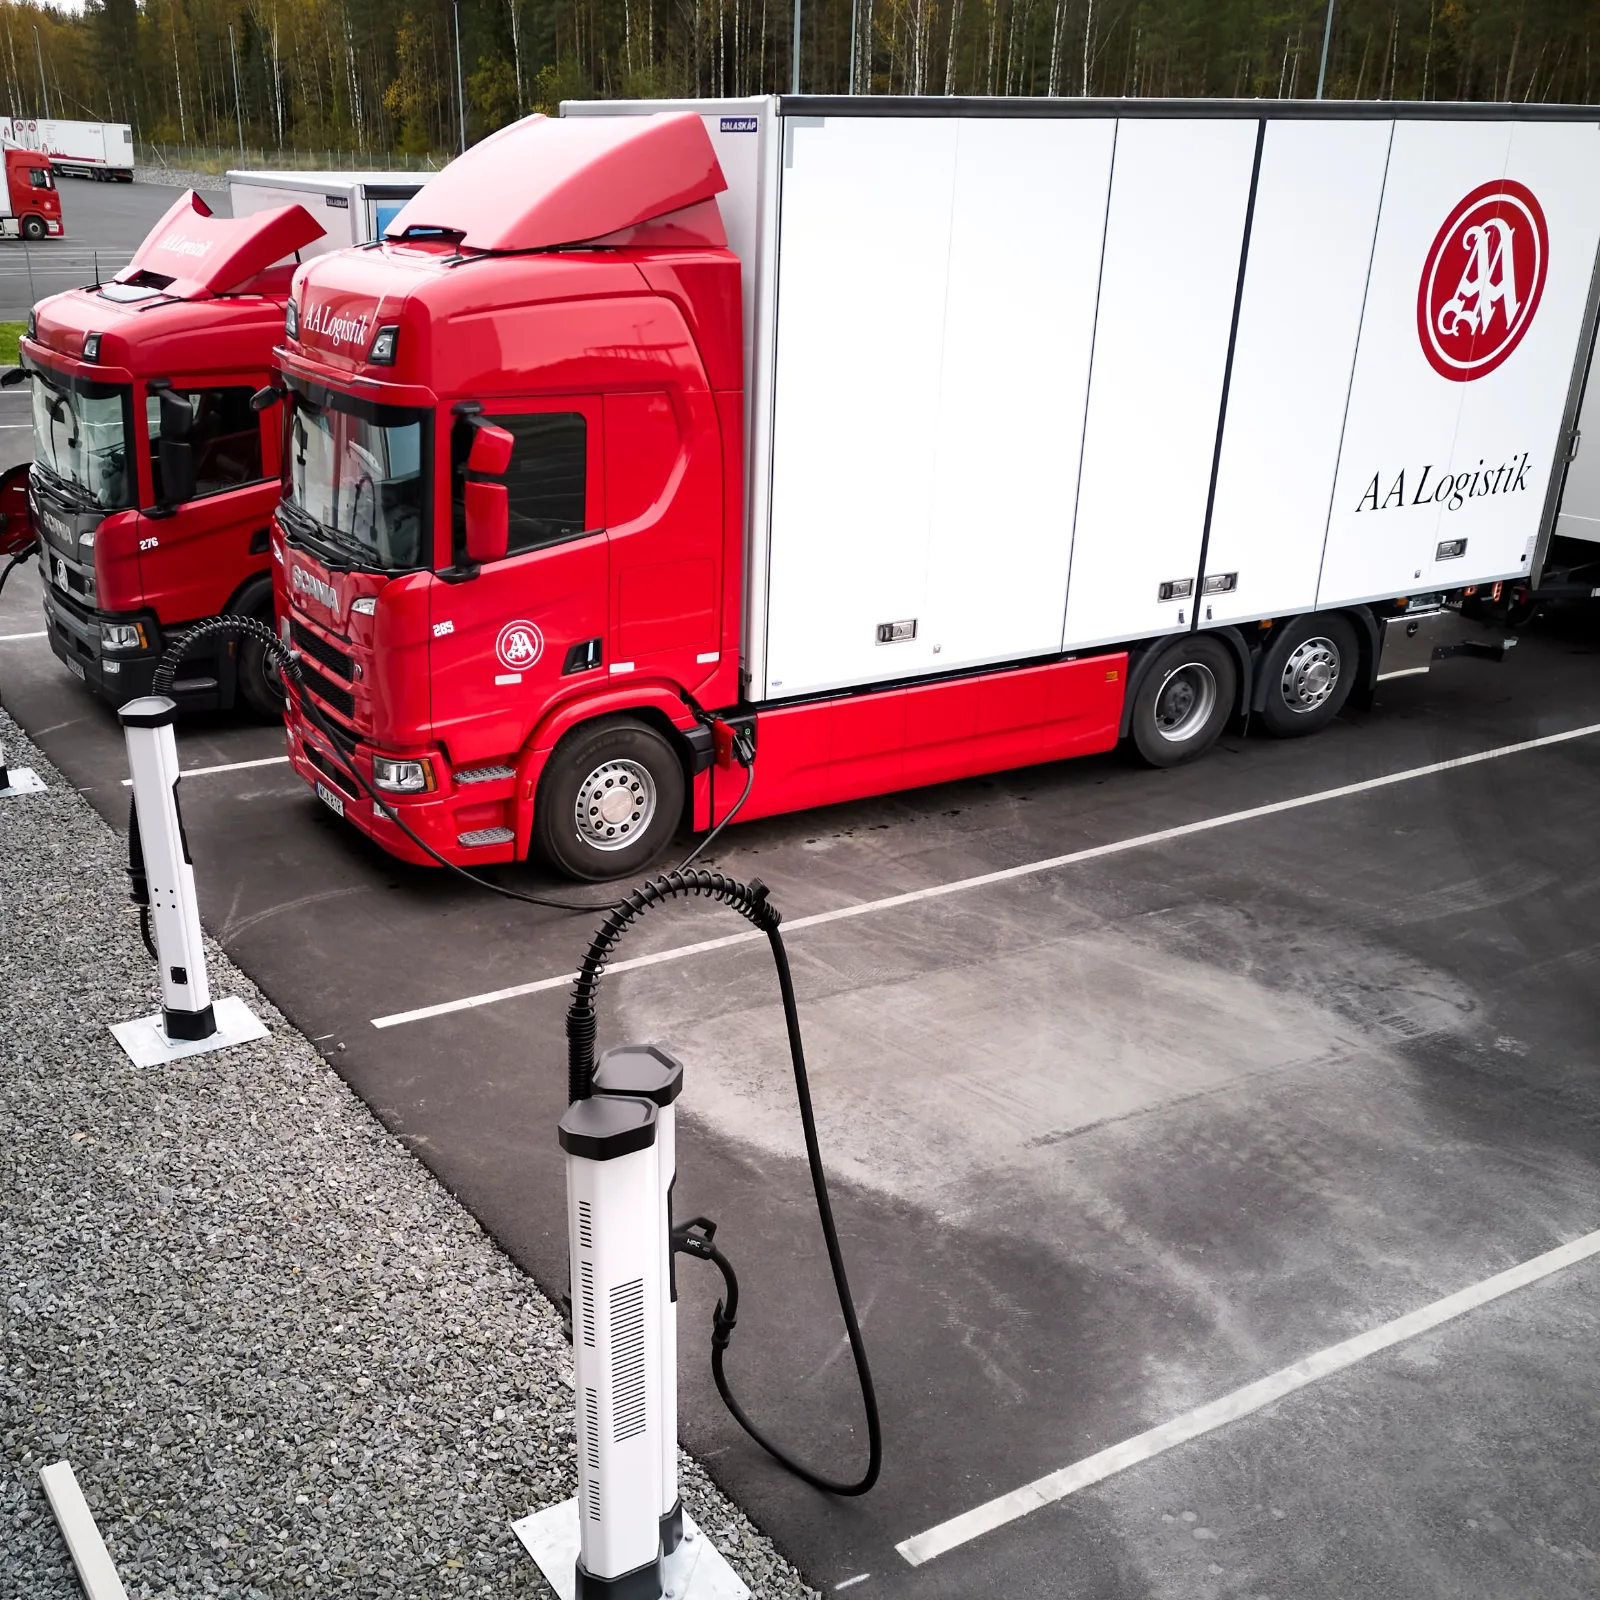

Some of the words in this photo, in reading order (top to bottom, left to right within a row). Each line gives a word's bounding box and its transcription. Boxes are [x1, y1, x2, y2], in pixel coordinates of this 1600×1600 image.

[320, 305, 368, 346] Logistik
[1410, 452, 1532, 511] Logistik
[139, 537, 159, 550] 276
[292, 564, 339, 614] SCANIA
[432, 620, 454, 637] 285
